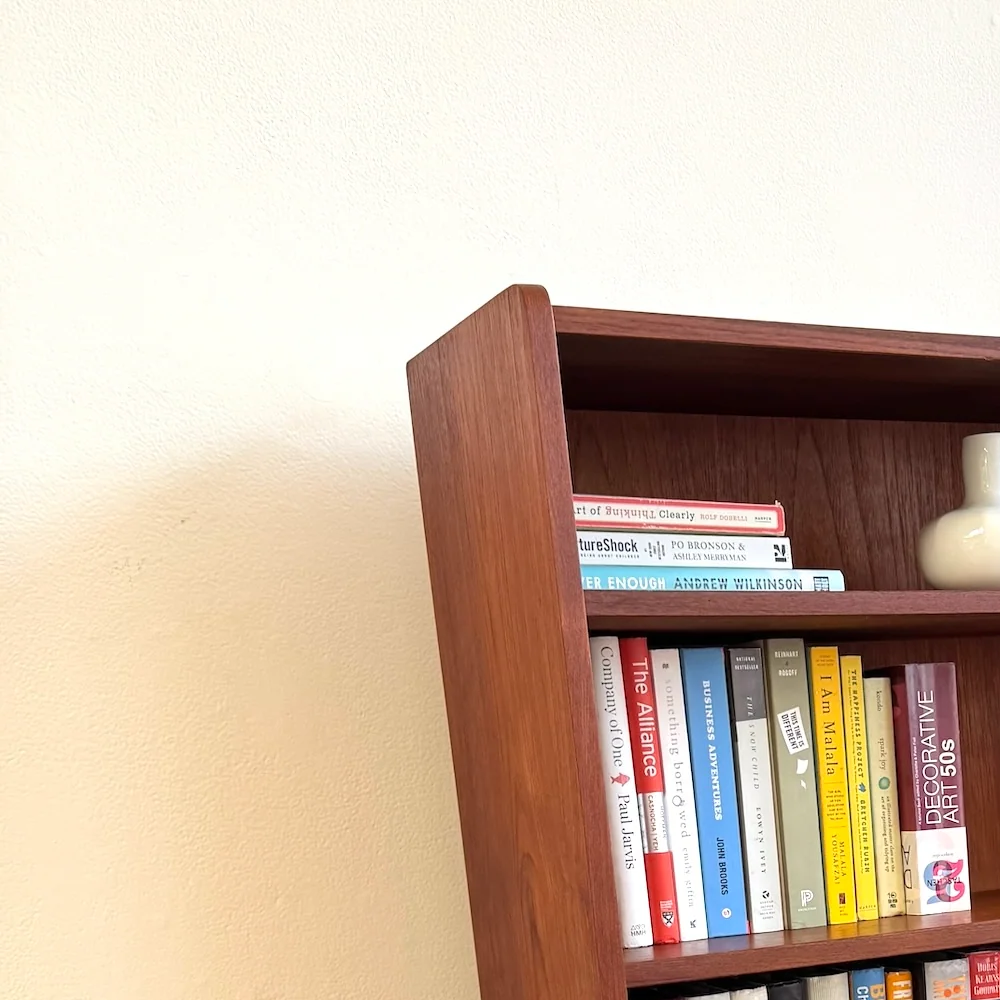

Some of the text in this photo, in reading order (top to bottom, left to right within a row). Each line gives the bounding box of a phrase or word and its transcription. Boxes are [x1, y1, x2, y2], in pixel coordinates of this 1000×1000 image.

[590, 506, 601, 516] of
[605, 505, 656, 520] Thinking
[659, 509, 695, 522] Clearly
[671, 540, 745, 551] PO BRONSON &
[673, 552, 747, 561] ASHLEY MERRYMAN
[608, 576, 666, 590] ENOUGH
[674, 577, 728, 590] ANDREW
[735, 578, 803, 590] WILKINSON
[601, 646, 624, 767] Company of One
[632, 657, 657, 777] The Alliance
[665, 680, 679, 755] something
[821, 688, 833, 714] Am
[852, 690, 861, 737] HAPPINESS
[781, 714, 799, 750] DIFFERENT
[790, 711, 805, 748] THIS TIME IS
[823, 721, 839, 775] Malala
[877, 737, 887, 757] spark
[746, 696, 754, 717] THE
[751, 756, 760, 790] CHILD
[756, 807, 764, 843] EOWYN
[855, 742, 864, 778] PROJECT
[879, 757, 887, 771] joy
[917, 690, 941, 825] DECORATIVE
[702, 680, 729, 896] BUSINESS ADVENTURES JOHN BROOKS
[940, 781, 960, 824] ART
[618, 794, 636, 870] Paul Jarvis
[860, 799, 868, 842] GRETCHEN
[832, 834, 840, 884] YOUSAFZAI
[839, 841, 847, 877] MALALA
[974, 985, 1000, 996] GOODWIN
[975, 973, 1000, 984] KEARNS
